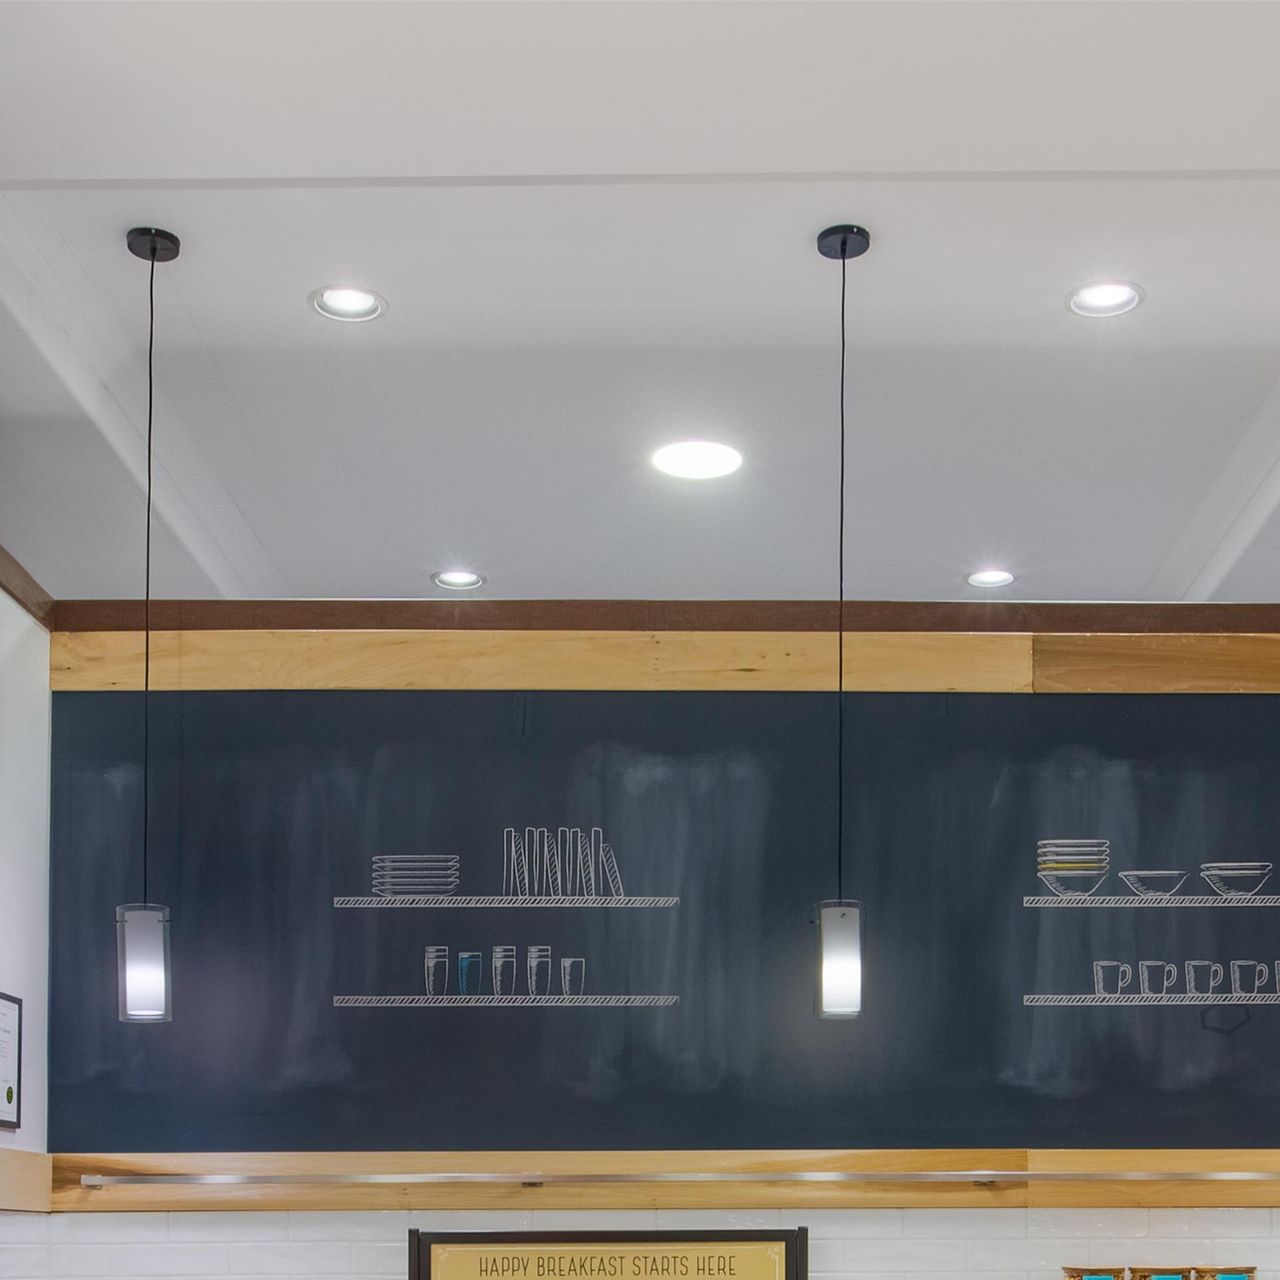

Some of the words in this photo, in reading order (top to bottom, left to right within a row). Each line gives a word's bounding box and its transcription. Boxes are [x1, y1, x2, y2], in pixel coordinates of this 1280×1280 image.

[479, 1256, 529, 1277] HAPPY
[536, 1256, 625, 1277] BREAKFAST
[632, 1255, 689, 1276] STARTS
[696, 1255, 736, 1276] HERE
